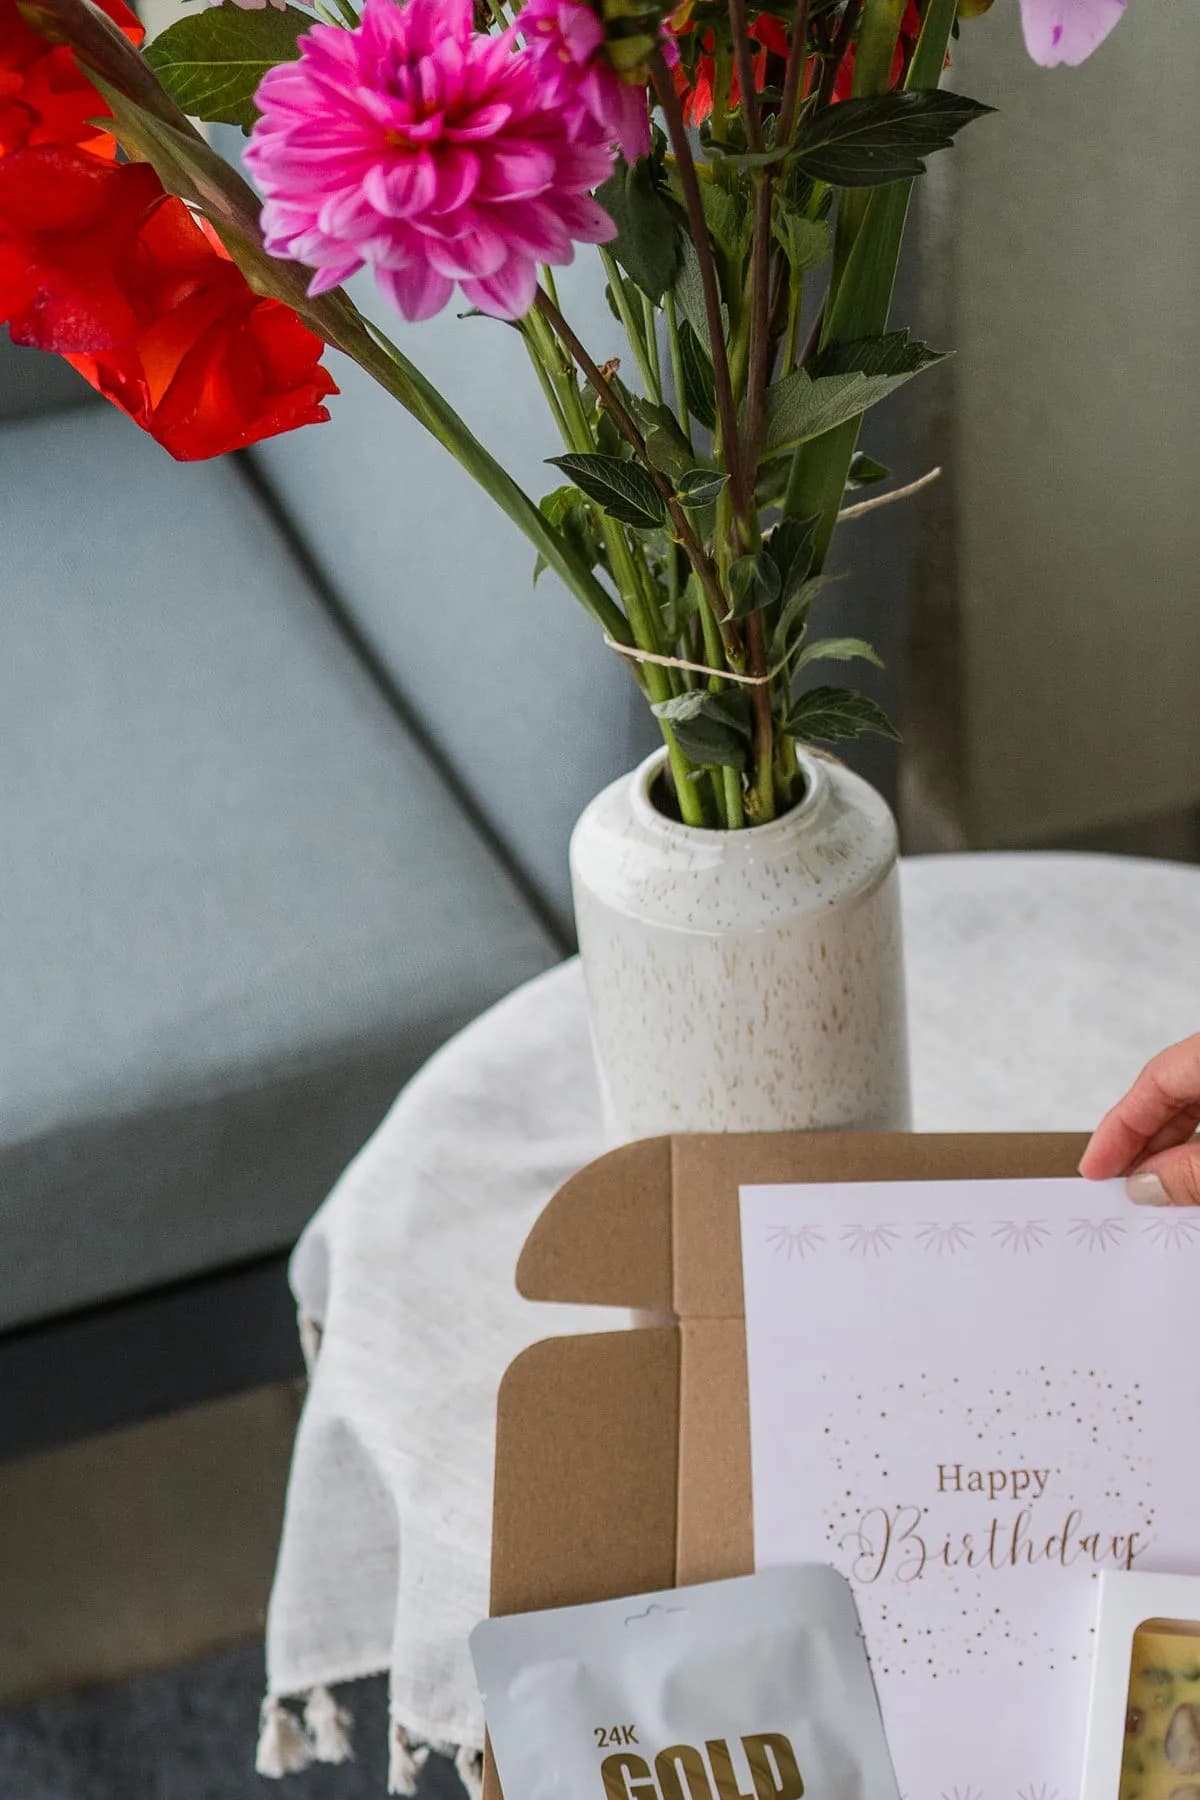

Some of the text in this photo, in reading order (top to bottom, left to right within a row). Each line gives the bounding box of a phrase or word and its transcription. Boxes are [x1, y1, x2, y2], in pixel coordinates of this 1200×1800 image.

[936, 1464, 1051, 1500] Happy
[838, 1505, 1151, 1583] Birthday
[594, 1725, 640, 1748] 24K
